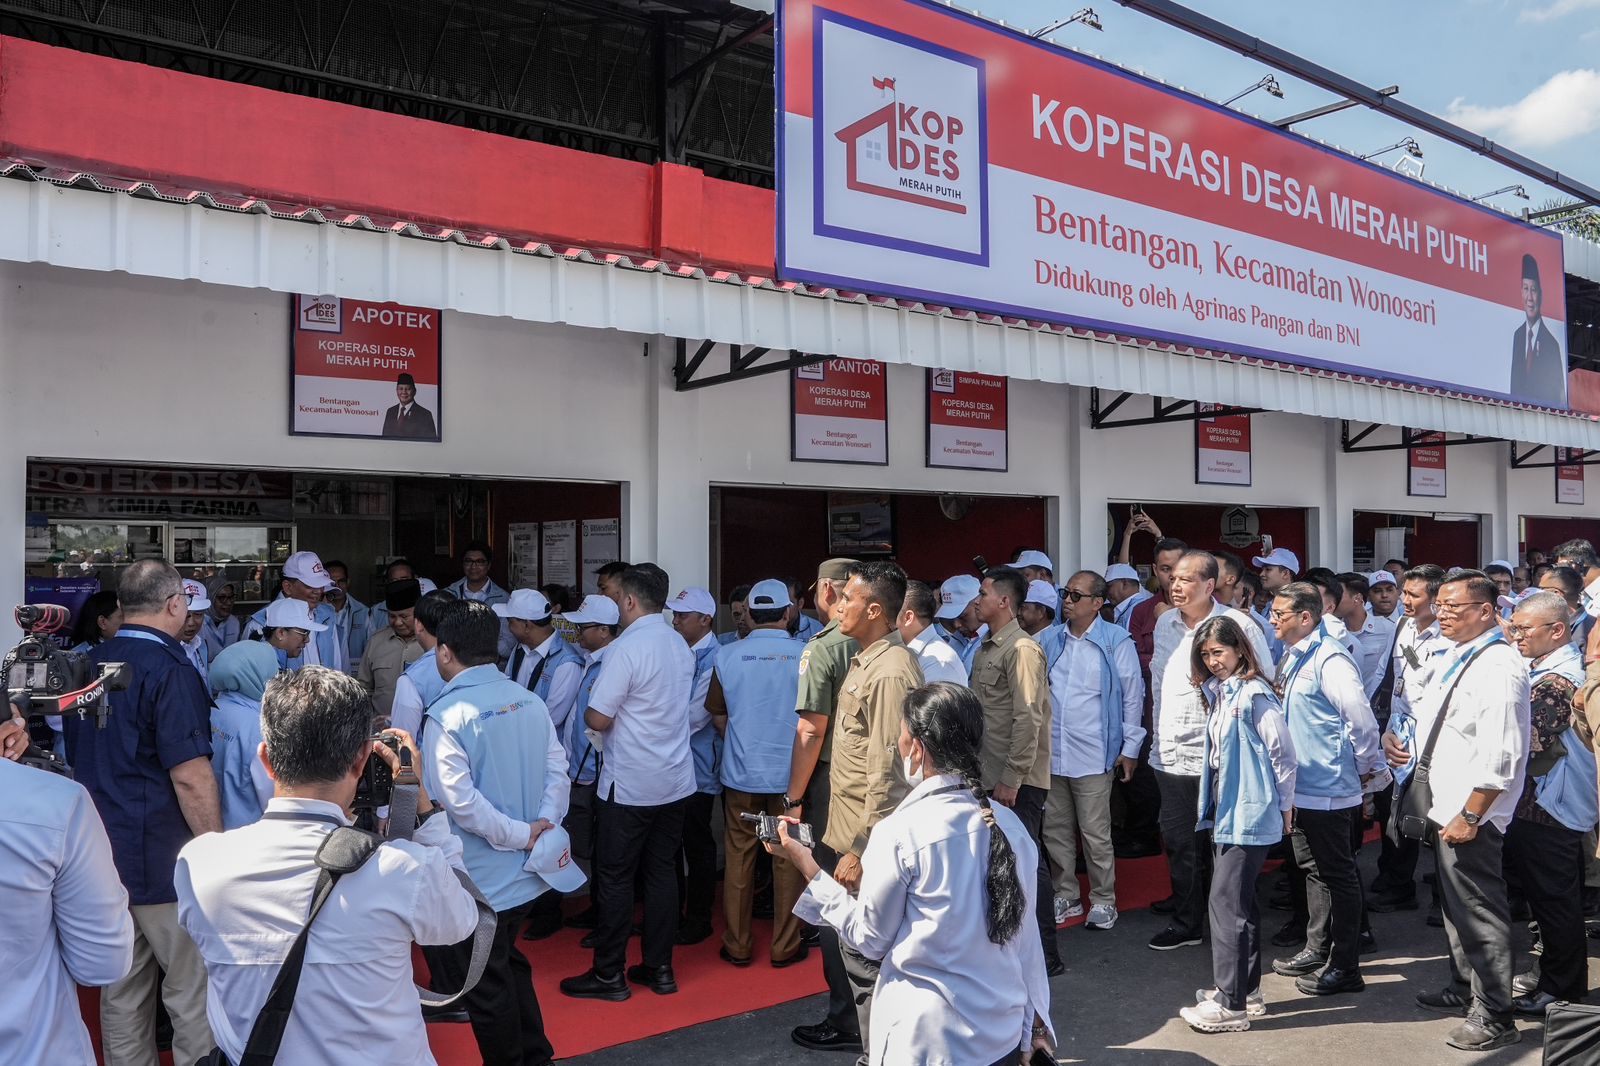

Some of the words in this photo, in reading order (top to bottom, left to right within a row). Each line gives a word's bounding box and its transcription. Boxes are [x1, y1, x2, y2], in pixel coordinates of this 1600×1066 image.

[899, 102, 963, 144] KOP
[899, 137, 960, 181] DES
[899, 177, 933, 193] MERAH
[935, 185, 962, 200] PUTIH
[1032, 93, 1230, 196] KOPERASI
[1241, 161, 1323, 225] DESA
[1329, 191, 1419, 254] MERAH
[1426, 224, 1488, 275] PUTIH
[1032, 194, 1203, 275] Bentangan,
[1213, 240, 1343, 303] Kecamatan
[1347, 275, 1436, 326] Wonosari
[318, 302, 336, 310] KOP
[1034, 259, 1134, 308] Didukung
[1139, 283, 1177, 310] oleh
[1182, 291, 1246, 323] Agrinas
[1251, 304, 1304, 337] Pangan
[1308, 318, 1332, 341] dan
[1336, 324, 1360, 347] BNI
[318, 310, 335, 318] DES
[352, 307, 432, 329] APOTEK
[318, 340, 380, 354] KOPERASI
[384, 346, 416, 358] DESA
[326, 354, 370, 367] MERAH
[374, 358, 408, 370] PUTIH
[829, 360, 880, 376] KANTOR
[958, 376, 980, 385] SIMPAN
[981, 380, 1002, 388] PINJAM
[809, 386, 849, 397] KOPERASI
[850, 390, 871, 399] DESA
[319, 397, 360, 406] Bentangan
[814, 397, 842, 406] MERAH
[844, 400, 866, 408] PUTIH
[942, 399, 976, 408] KOPERASI
[976, 402, 994, 410] DESA
[299, 405, 343, 414] Kecamatan
[344, 407, 379, 416] Wonosari
[946, 409, 970, 418] MERAH
[971, 412, 990, 420] PUTIH
[826, 430, 858, 440] Bentangan
[1206, 427, 1228, 435] KOPERASI
[811, 438, 844, 447] Kecamatan
[844, 440, 872, 448] Wonosari
[172, 470, 266, 496] DESA
[98, 497, 172, 514] KIMIA
[181, 499, 262, 516] FARMA
[76, 683, 104, 705] RONIN
